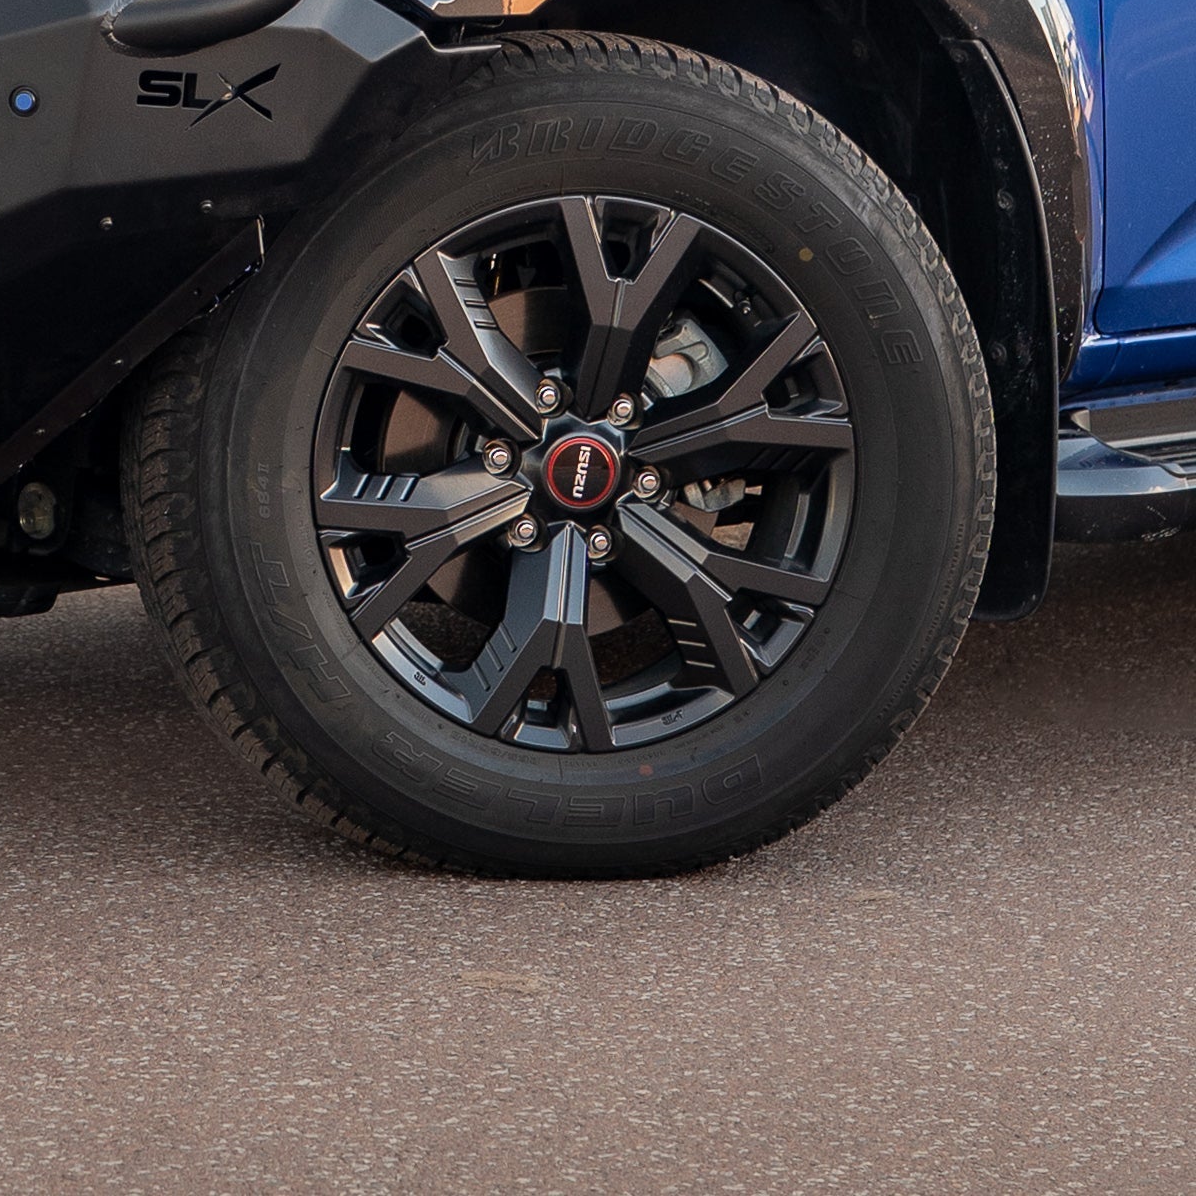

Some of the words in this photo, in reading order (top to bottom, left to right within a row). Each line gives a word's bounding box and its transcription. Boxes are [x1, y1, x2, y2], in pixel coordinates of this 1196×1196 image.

[136, 62, 282, 131] SLX
[468, 117, 923, 366] BRIDGESTONE
[572, 445, 592, 499] ISUZU
[371, 730, 764, 827] DUELER
